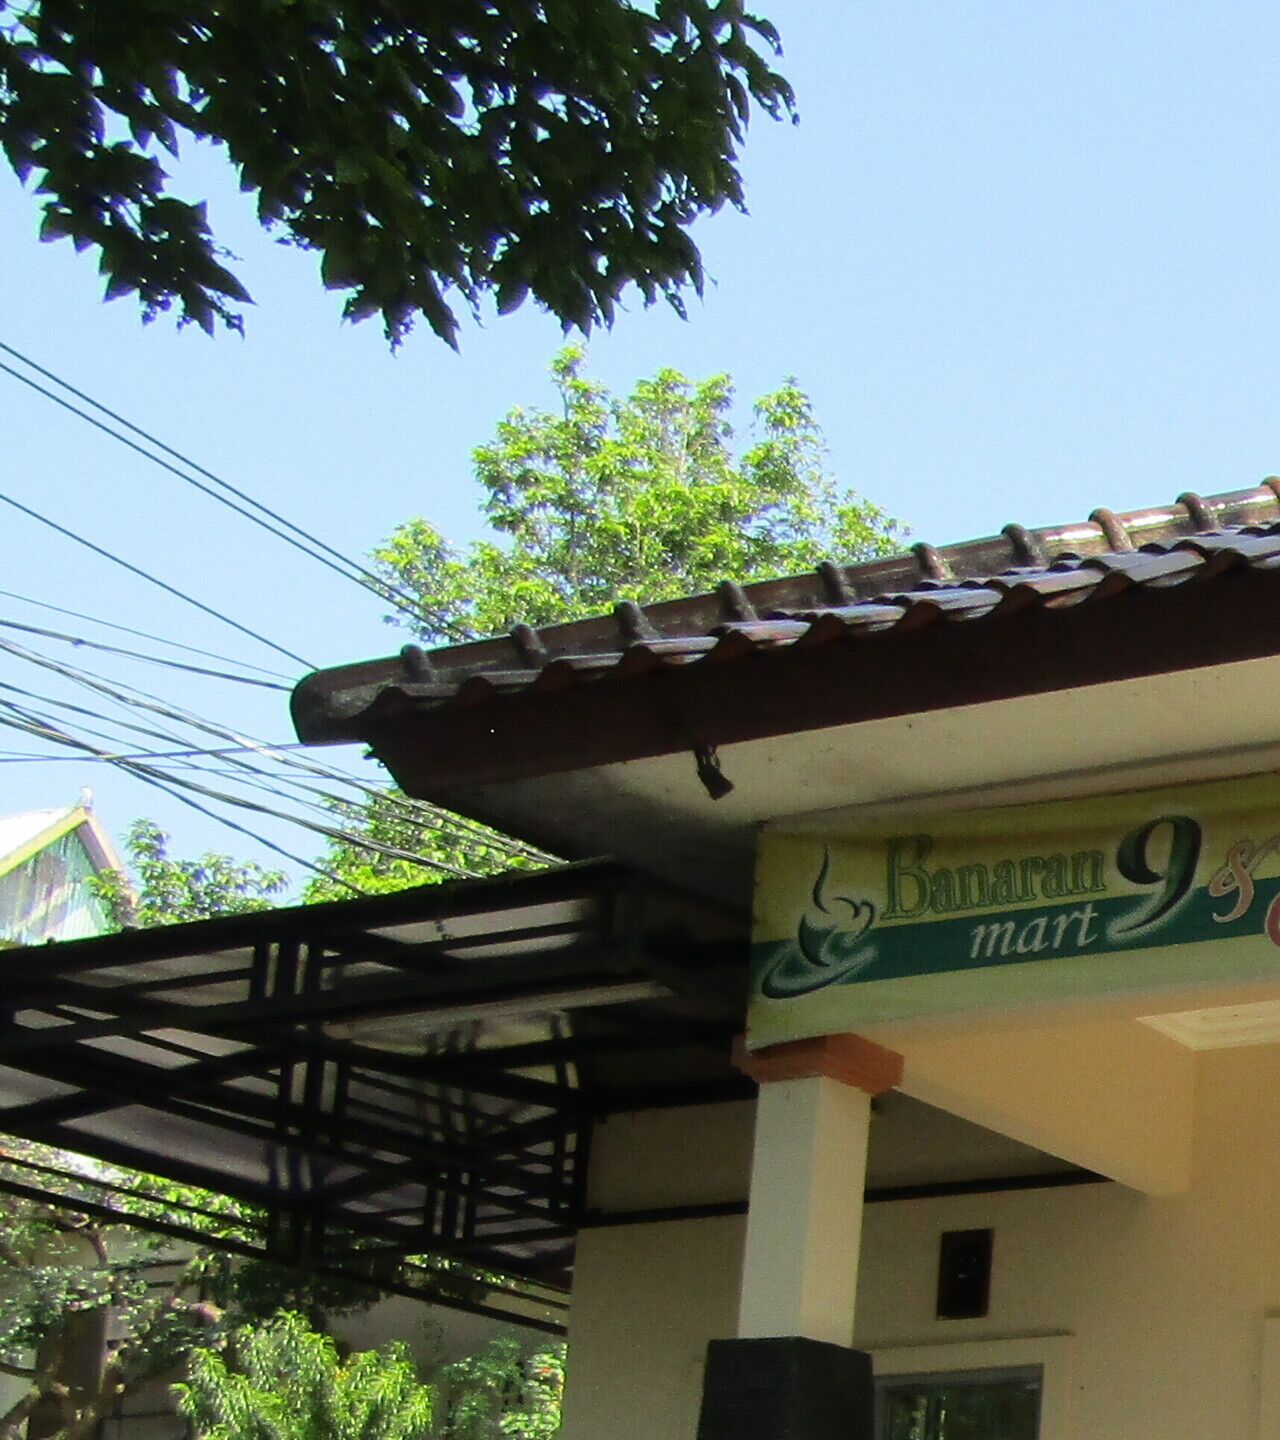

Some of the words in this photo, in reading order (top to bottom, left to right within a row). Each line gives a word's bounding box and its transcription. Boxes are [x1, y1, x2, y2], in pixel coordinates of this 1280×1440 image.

[881, 834, 1106, 919] Banaran
[1112, 814, 1202, 936] 9
[969, 903, 1099, 960] mart
